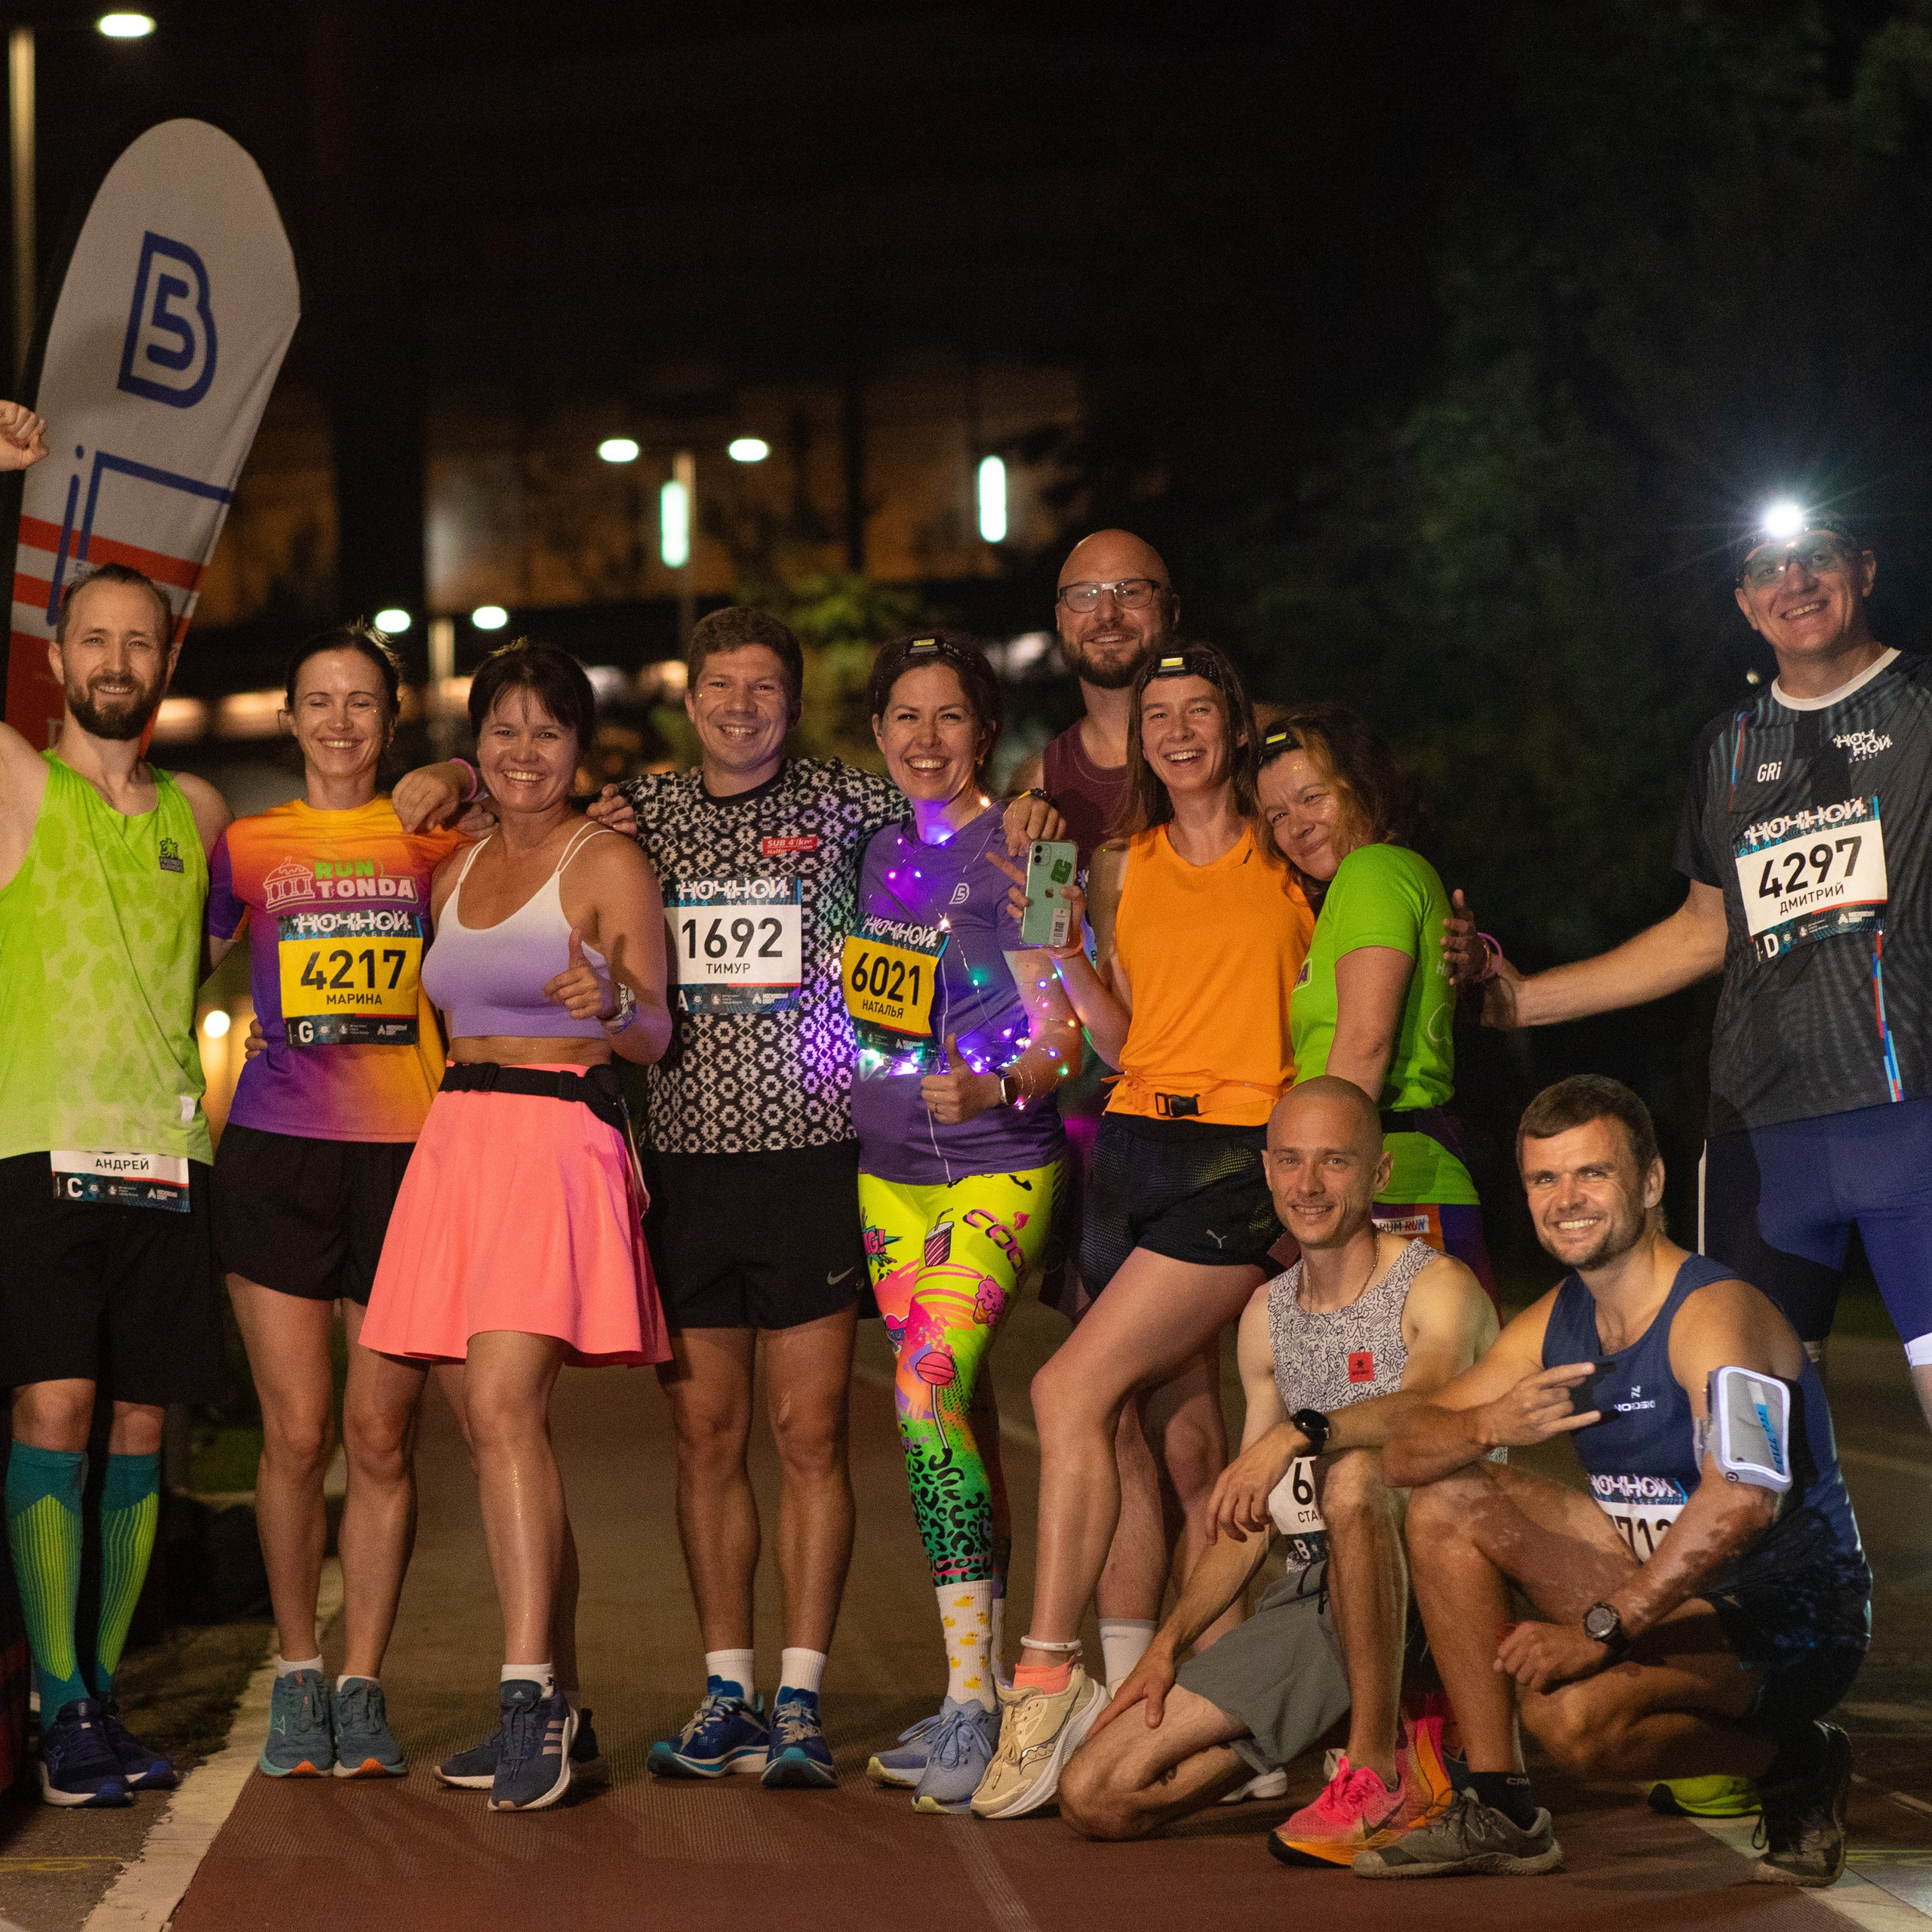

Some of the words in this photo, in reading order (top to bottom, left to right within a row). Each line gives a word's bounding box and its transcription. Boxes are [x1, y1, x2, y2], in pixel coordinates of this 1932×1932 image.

[1744, 796, 1867, 844] НОЧНОЙ
[314, 859, 374, 879] RUN
[1758, 835, 1862, 899] 4297
[316, 878, 416, 898] TONDA
[676, 877, 790, 900] НОЧНОЙ
[1780, 882, 1844, 915] ДМИТРИЙ
[294, 910, 412, 933] НОЧНОЙ
[682, 918, 783, 959] 1692
[1764, 933, 1780, 958] D
[300, 949, 407, 990] 4217
[706, 963, 750, 974] ТИМУР
[851, 952, 921, 1006] 6021
[326, 993, 383, 1006] МАРИНА
[862, 998, 904, 1019] НАТАЛЬЯ
[298, 1021, 314, 1043] G
[95, 1158, 149, 1171] АНДРЕЙ
[66, 1177, 83, 1198] C
[1293, 1461, 1314, 1505] 6
[1297, 1510, 1321, 1523] СТА
